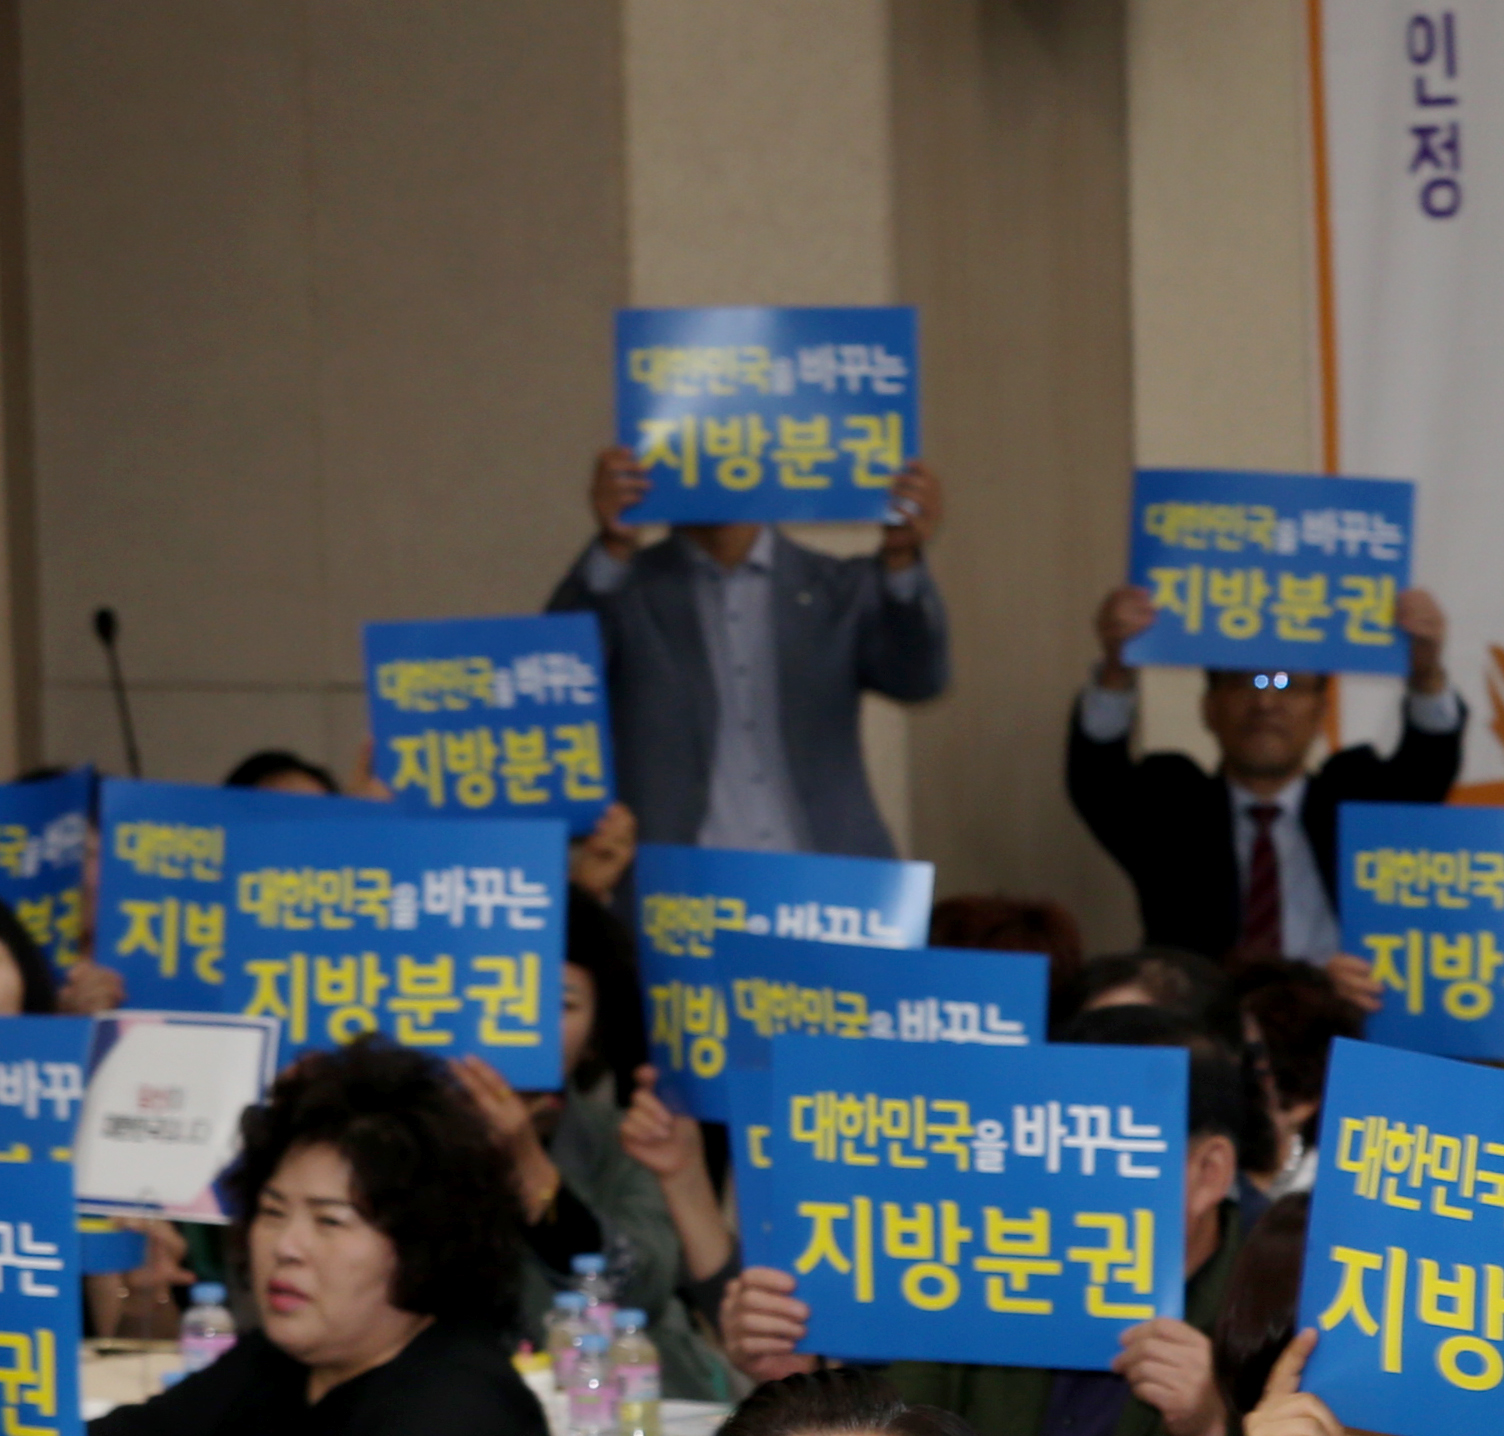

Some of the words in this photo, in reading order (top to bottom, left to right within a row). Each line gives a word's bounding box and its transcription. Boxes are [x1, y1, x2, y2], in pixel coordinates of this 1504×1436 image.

[1405, 9, 1462, 219] 인정
[629, 345, 793, 396] 대한민국을
[800, 343, 907, 396] 바꾸는
[638, 413, 903, 491] 지방분권
[1143, 501, 1297, 557] 대한민국을
[1301, 510, 1404, 559] 바꾸는
[1146, 566, 1397, 644] 지방분권
[378, 655, 513, 712] 대한민국을
[513, 653, 598, 705] 바꾸는
[389, 721, 606, 807] 지방분권
[114, 820, 224, 882] 대한민
[238, 868, 417, 930] 대한민국을
[422, 867, 551, 930] 바꾸는
[243, 951, 542, 1046] 지방분권
[0, 1060, 84, 1119] 바꾸
[789, 1092, 1008, 1174] 대한민국을
[1013, 1101, 1166, 1177] 바꾸는
[795, 1196, 1156, 1319] 지방분권
